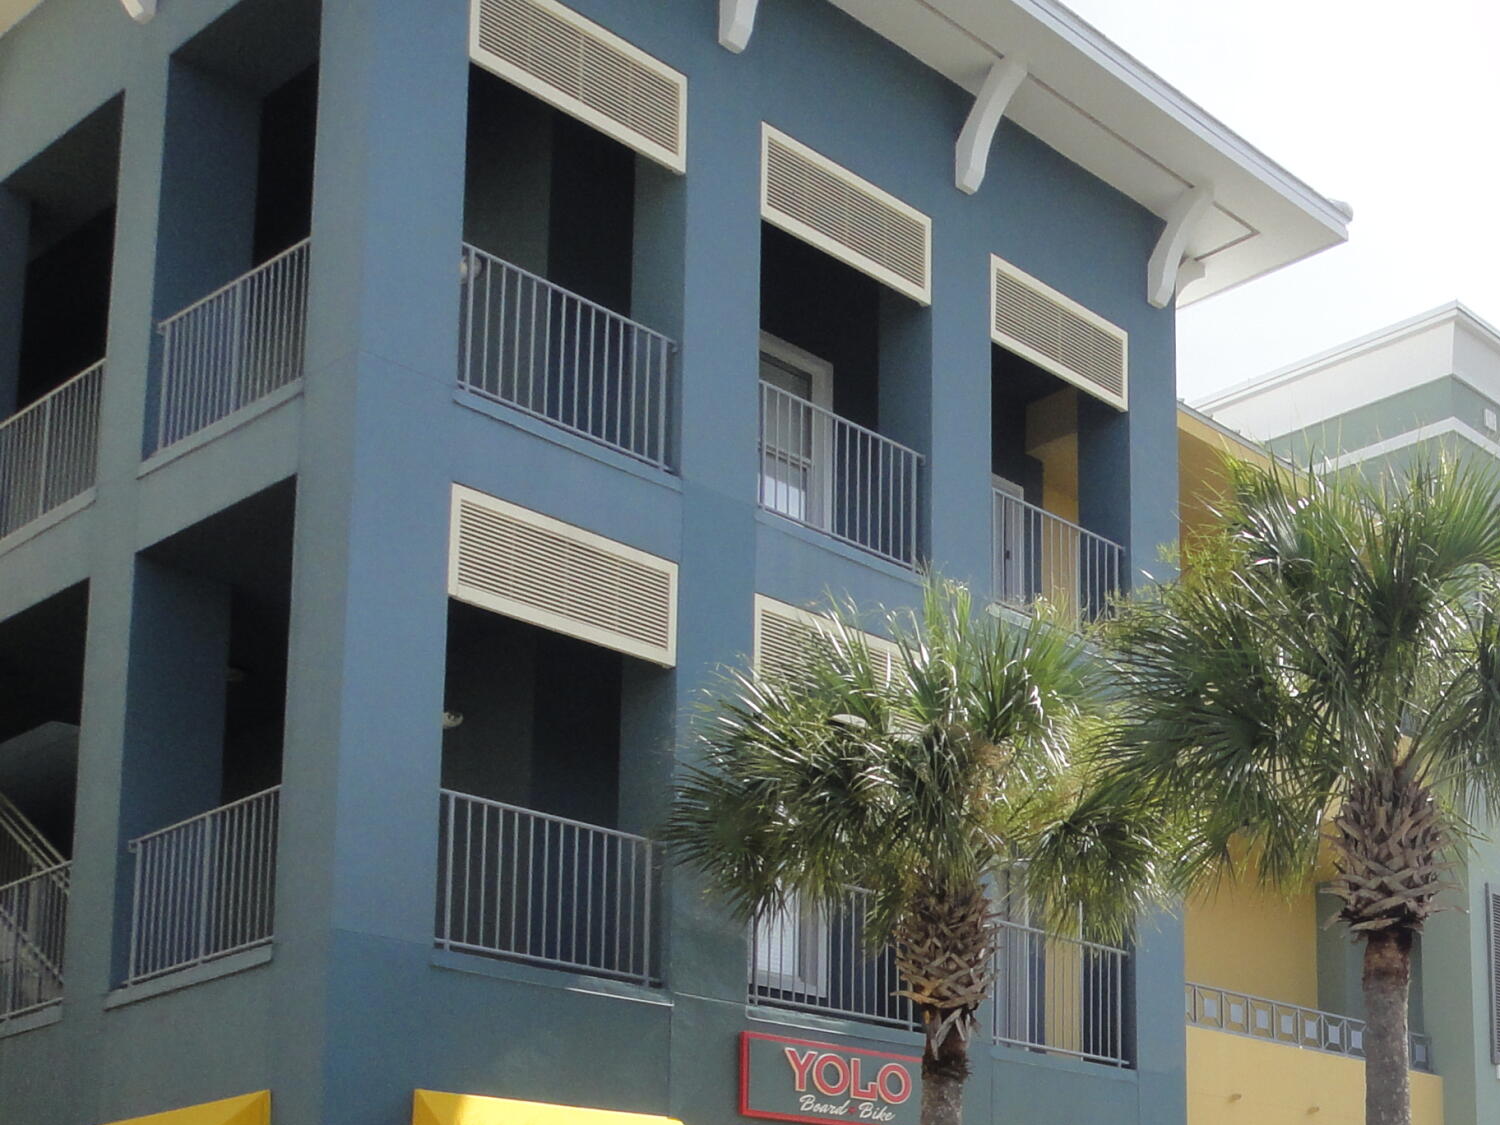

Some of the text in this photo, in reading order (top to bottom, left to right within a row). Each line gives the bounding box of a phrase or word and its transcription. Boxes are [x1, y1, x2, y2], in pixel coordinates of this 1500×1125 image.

[785, 1047, 912, 1104] YOLO
[799, 1094, 896, 1122] Board Bike
